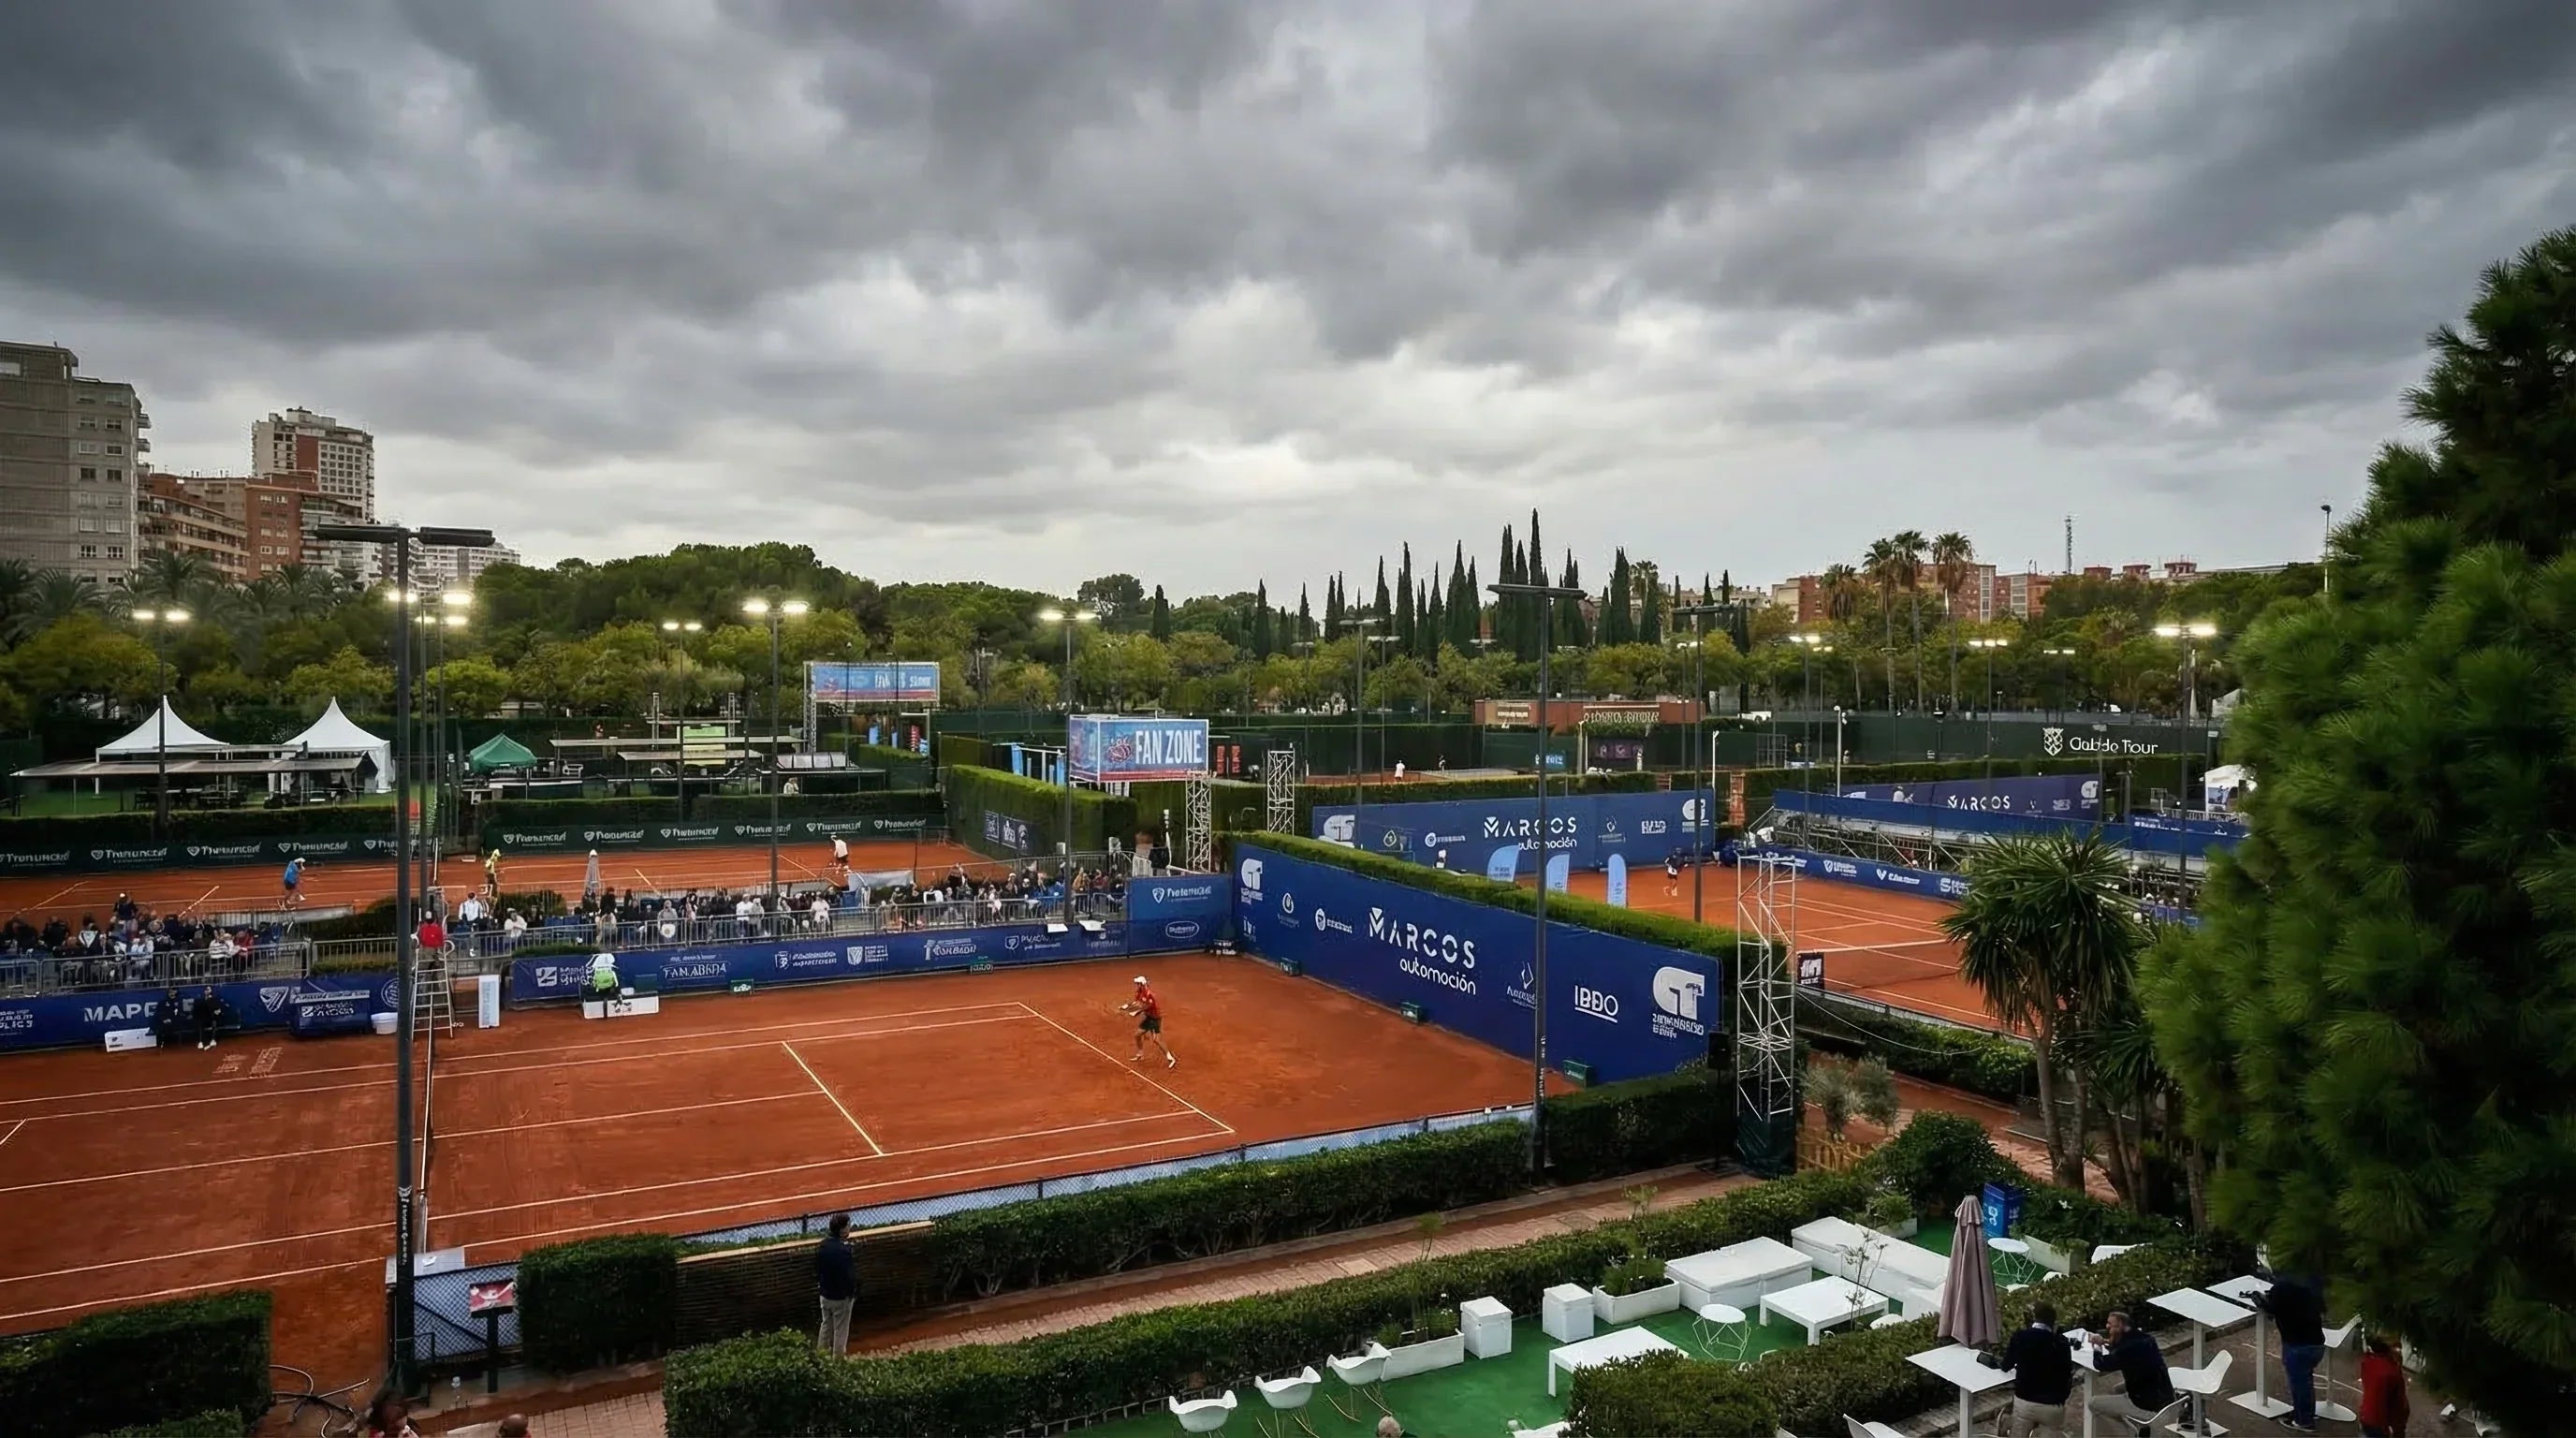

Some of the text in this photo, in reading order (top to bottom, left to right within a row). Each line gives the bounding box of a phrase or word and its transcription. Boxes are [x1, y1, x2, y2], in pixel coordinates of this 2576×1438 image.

[1135, 729, 1204, 765] FAN ZONE
[1484, 816, 1577, 838] MARCOS
[1369, 907, 1475, 969] MARCOS
[1399, 957, 1476, 995] automoción
